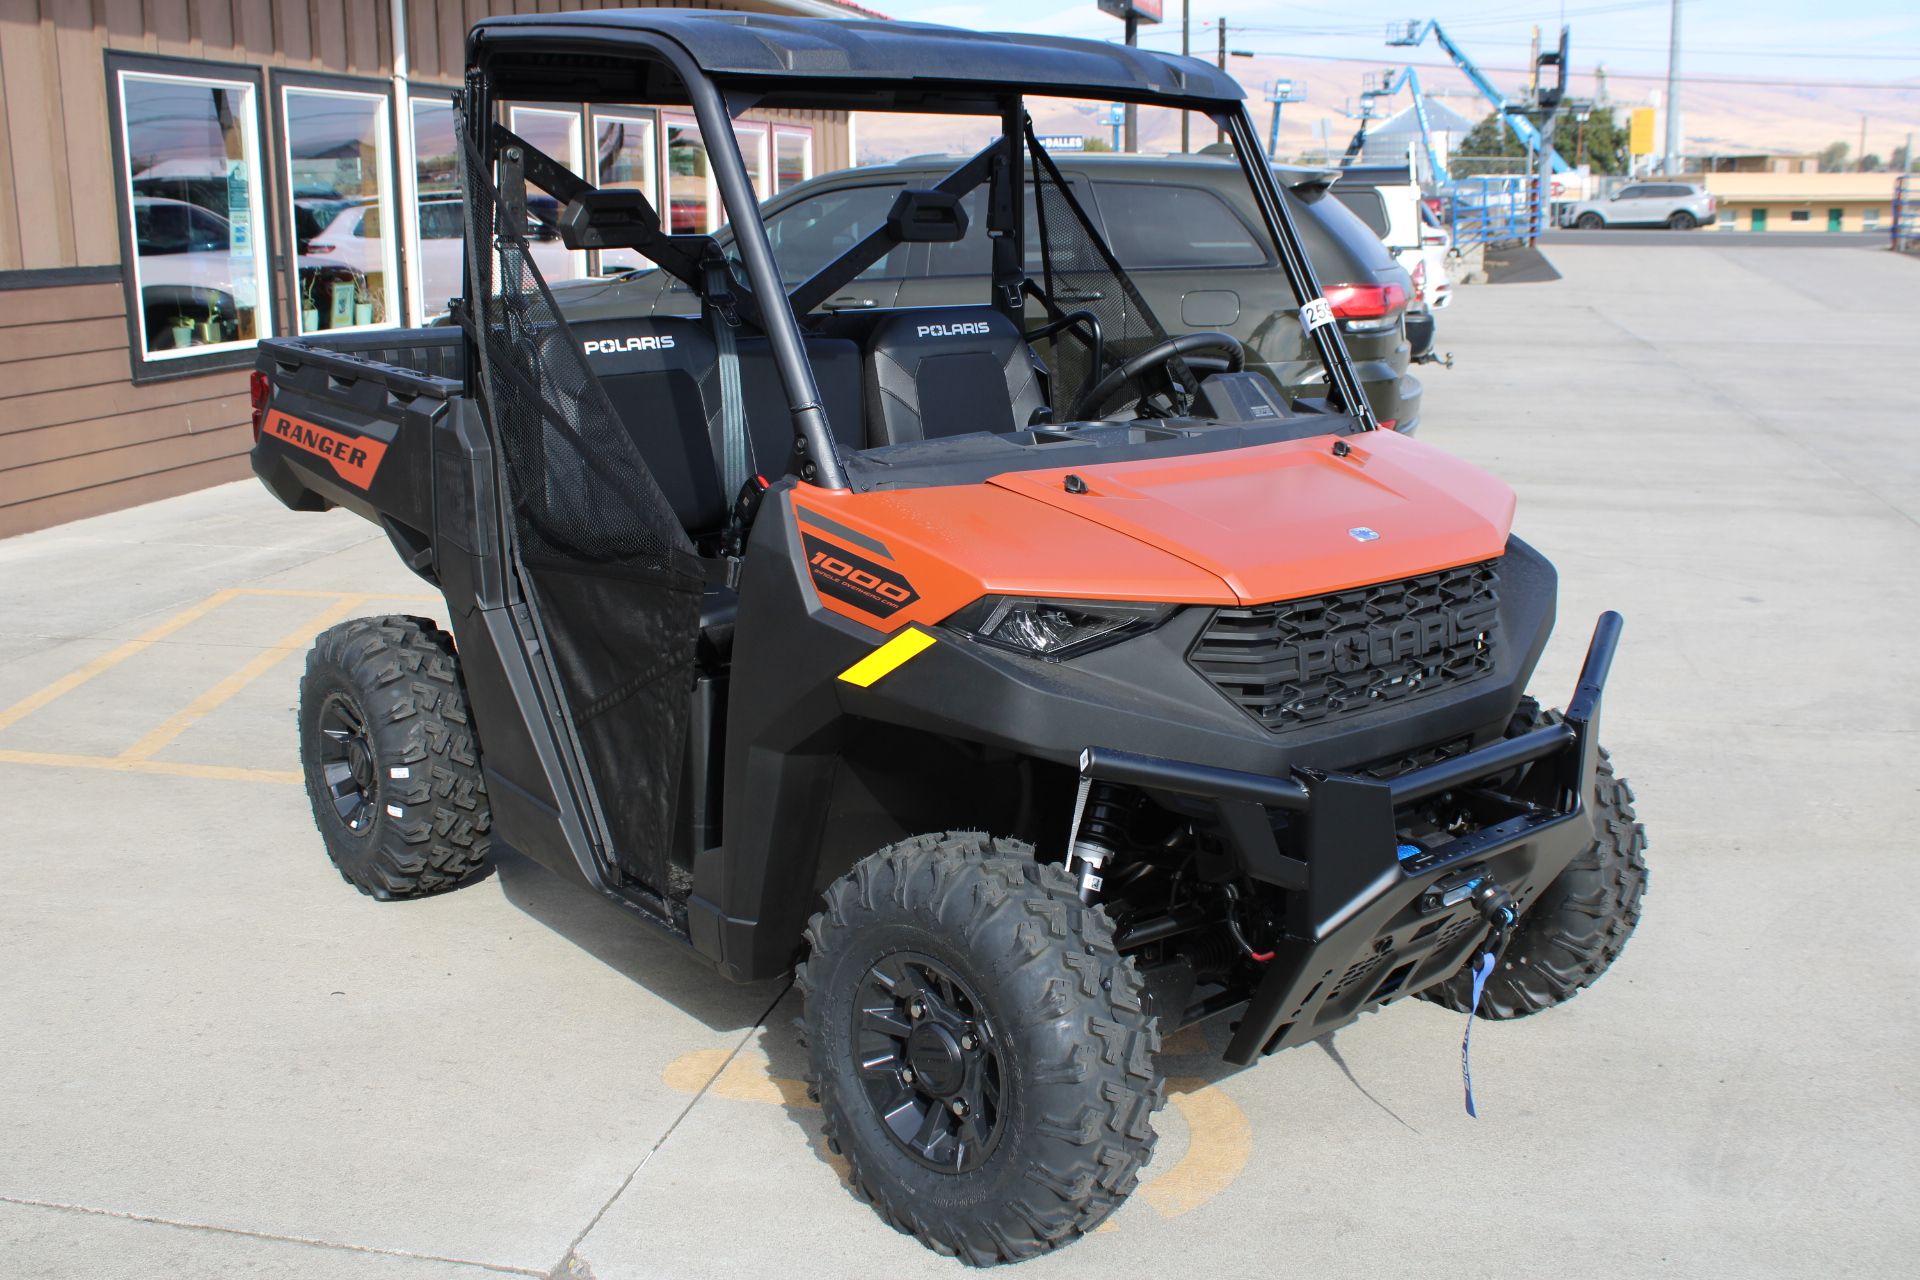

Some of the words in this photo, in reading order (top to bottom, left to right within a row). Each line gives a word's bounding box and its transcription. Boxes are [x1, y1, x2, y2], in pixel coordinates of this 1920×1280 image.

[1045, 136, 1083, 149] DALLES
[583, 335, 675, 355] POLARIS
[917, 322, 990, 338] POLARIS
[276, 418, 367, 468] RANGER
[810, 551, 911, 602] 1000
[1298, 600, 1499, 681] POLARIS
